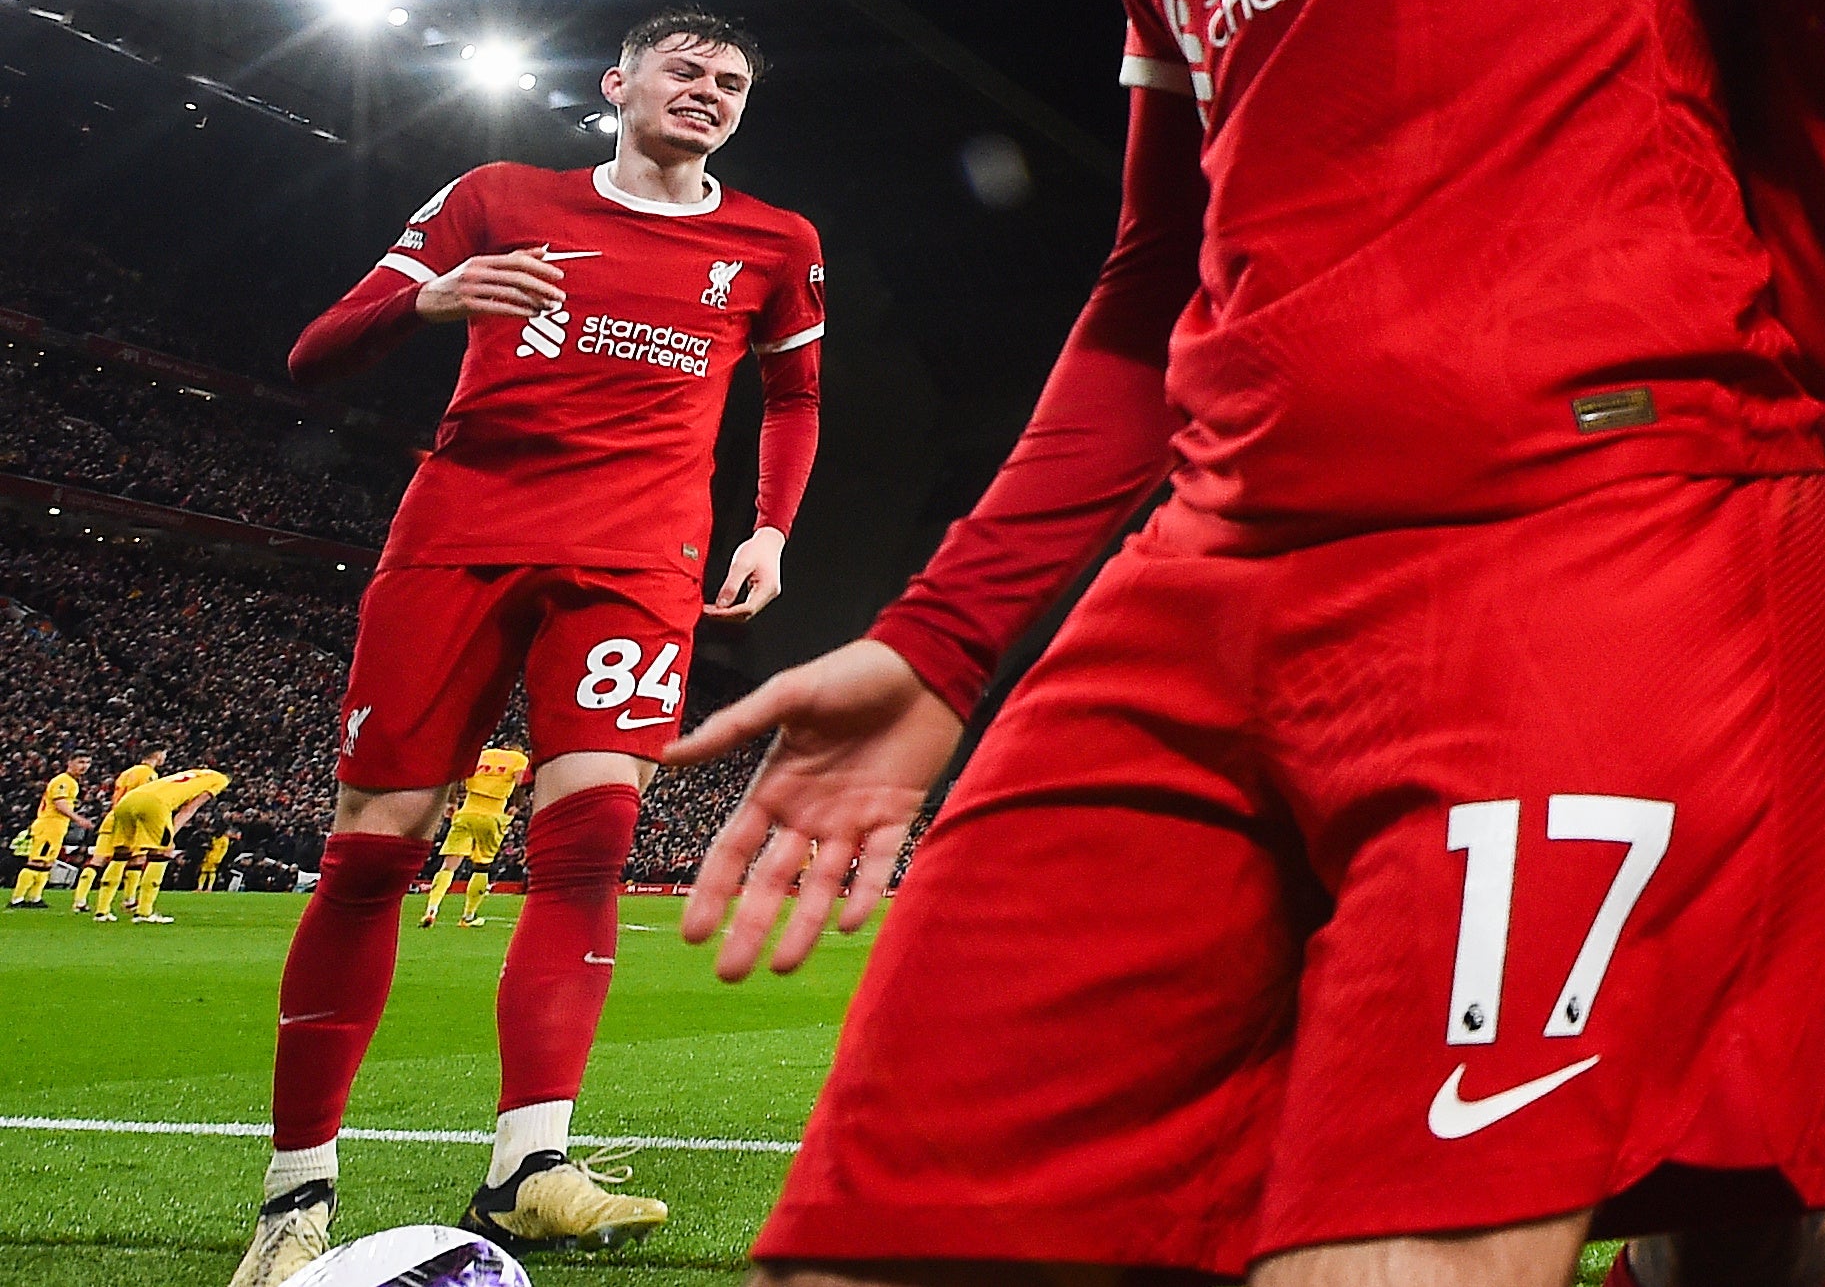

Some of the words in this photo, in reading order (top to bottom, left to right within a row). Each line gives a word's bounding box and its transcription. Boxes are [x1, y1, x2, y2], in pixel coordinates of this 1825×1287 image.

[577, 333, 709, 378] chartered
[582, 314, 712, 357] standard
[576, 638, 681, 715] 84
[1447, 794, 1676, 1045] 17
